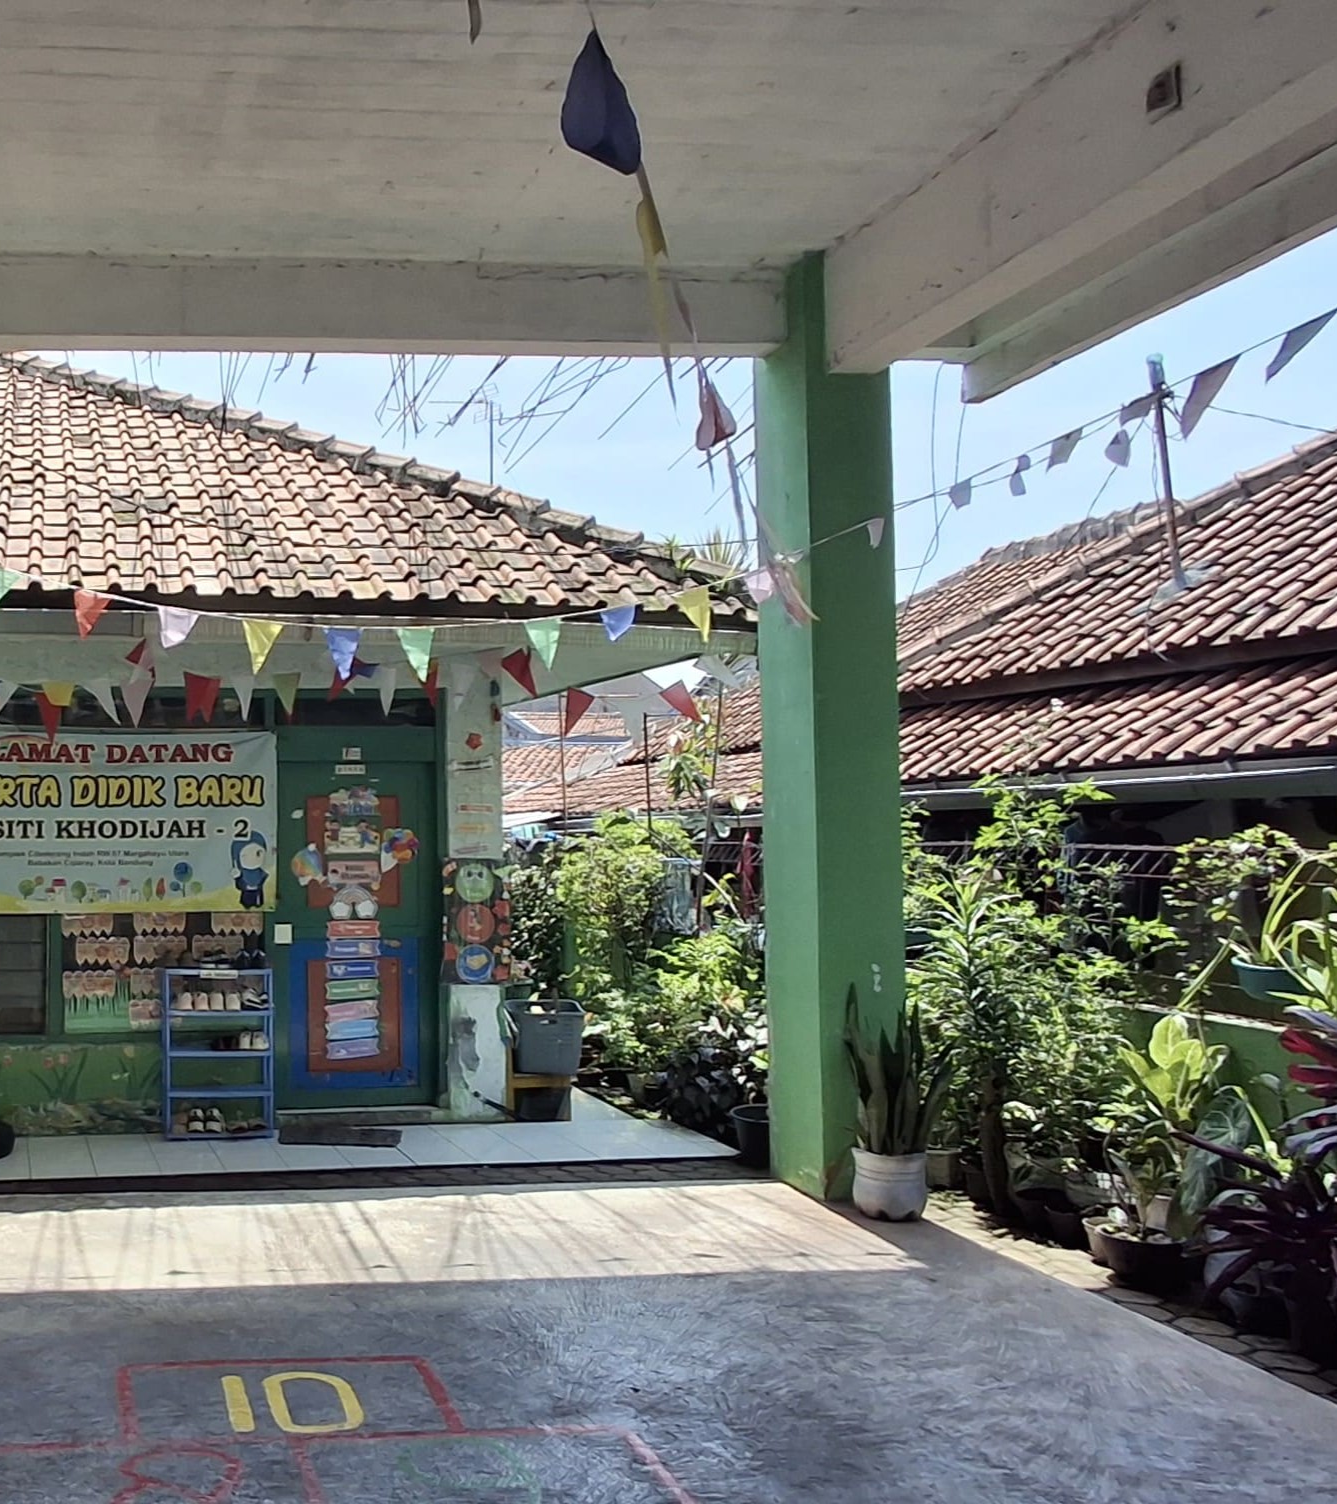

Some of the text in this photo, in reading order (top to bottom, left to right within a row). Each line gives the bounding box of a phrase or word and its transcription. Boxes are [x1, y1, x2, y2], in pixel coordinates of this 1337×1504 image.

[106, 743, 233, 763] DATANG
[71, 775, 165, 807] DIDIK
[175, 774, 264, 807] BARU
[55, 820, 205, 839] KHODIJAH
[234, 819, 249, 838] 2
[219, 1371, 365, 1433] 10
